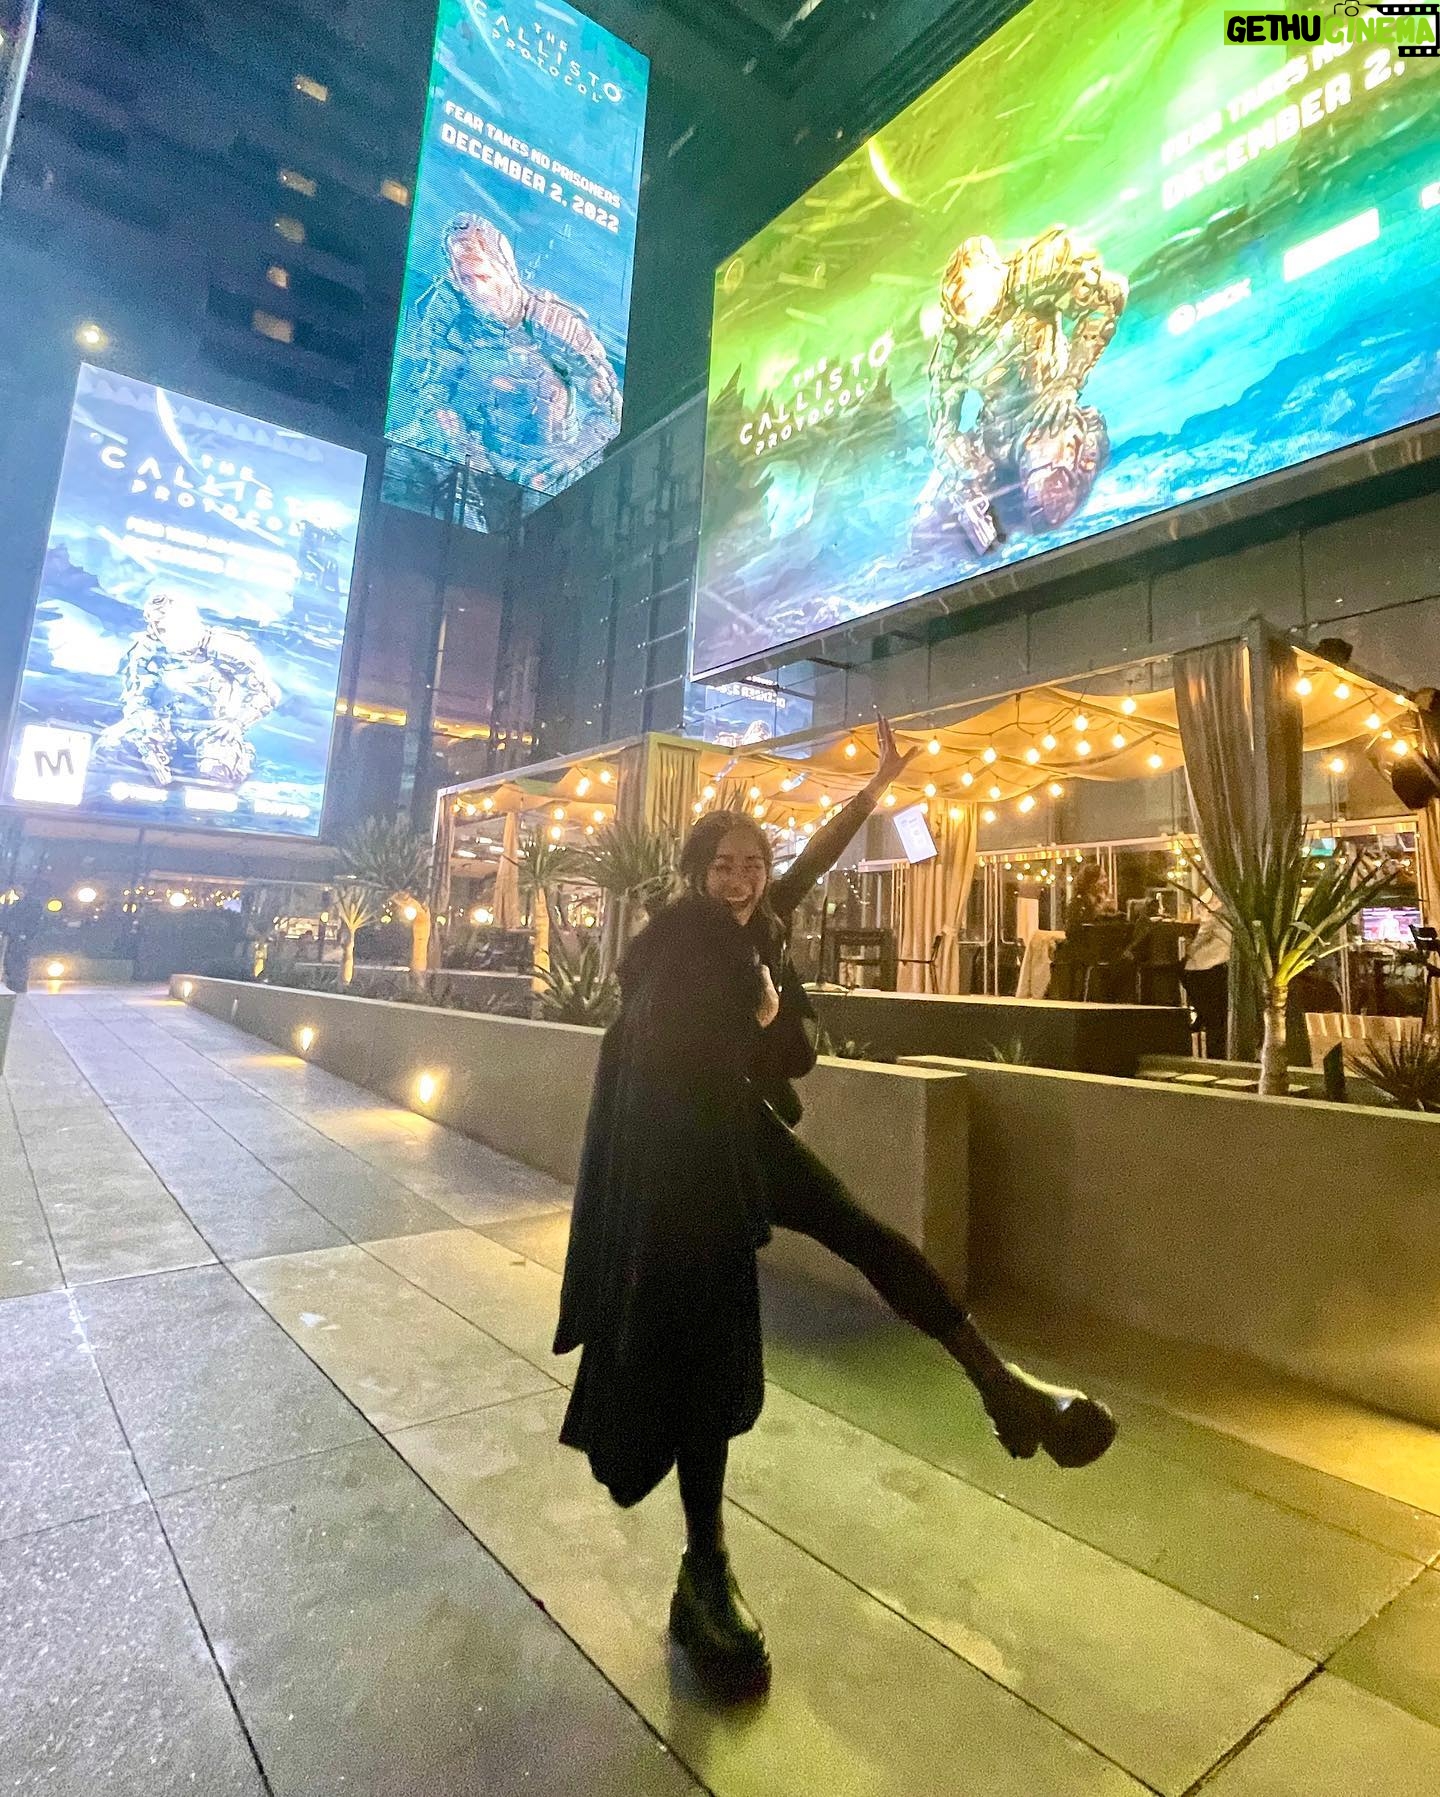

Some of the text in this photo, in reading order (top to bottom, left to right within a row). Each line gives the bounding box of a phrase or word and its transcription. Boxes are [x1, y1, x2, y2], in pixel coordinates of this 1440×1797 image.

[472, 0, 622, 102] CALLISTO
[491, 28, 601, 102] PROTOCOL
[534, 22, 568, 52] THE
[441, 123, 546, 194] DECEMBER
[572, 195, 620, 234] 2022
[445, 100, 621, 208] FEAR TAKES NO PRISONERS
[1161, 72, 1352, 211] DECEMBER
[739, 332, 893, 445] CALLISTO
[793, 357, 828, 387] THE
[755, 382, 866, 456] PROTOCOL
[34, 748, 74, 777] M
